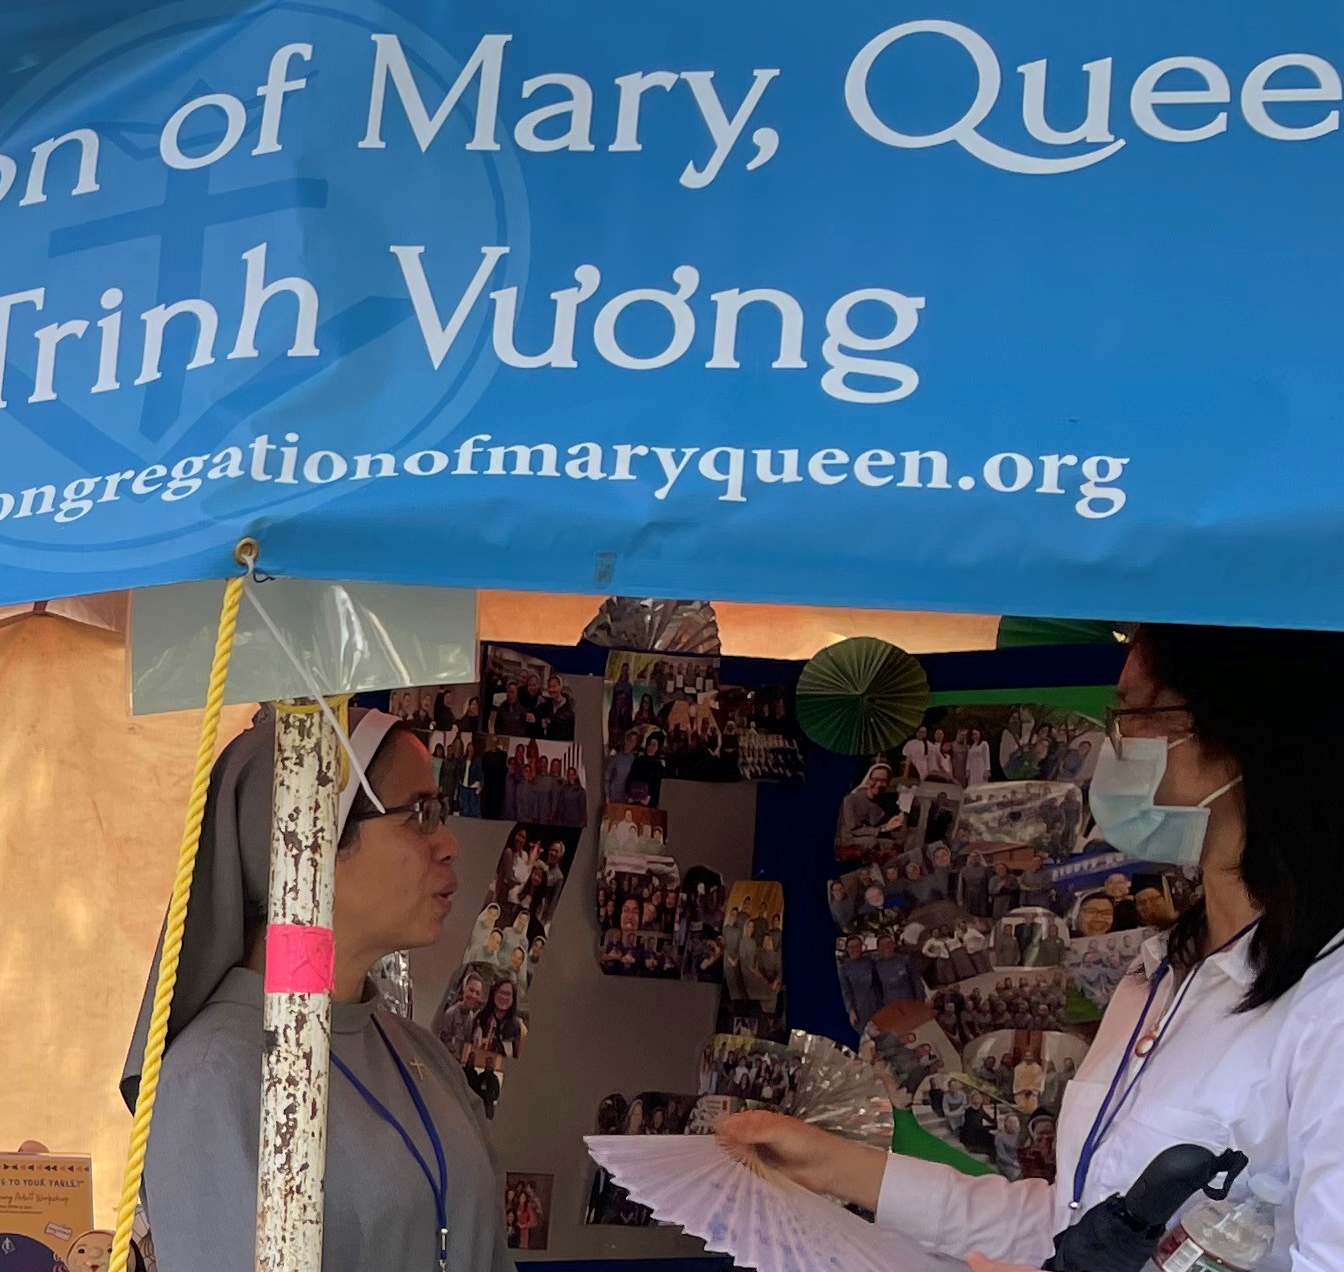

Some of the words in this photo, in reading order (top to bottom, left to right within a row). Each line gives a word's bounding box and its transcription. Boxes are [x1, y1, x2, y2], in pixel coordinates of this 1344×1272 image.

[160, 43, 312, 169] of
[358, 33, 779, 189] Mary,
[844, 18, 1344, 175] Quee
[389, 244, 926, 404] Vương
[9, 1178, 19, 1186] TO
[23, 1178, 46, 1186] YOUR
